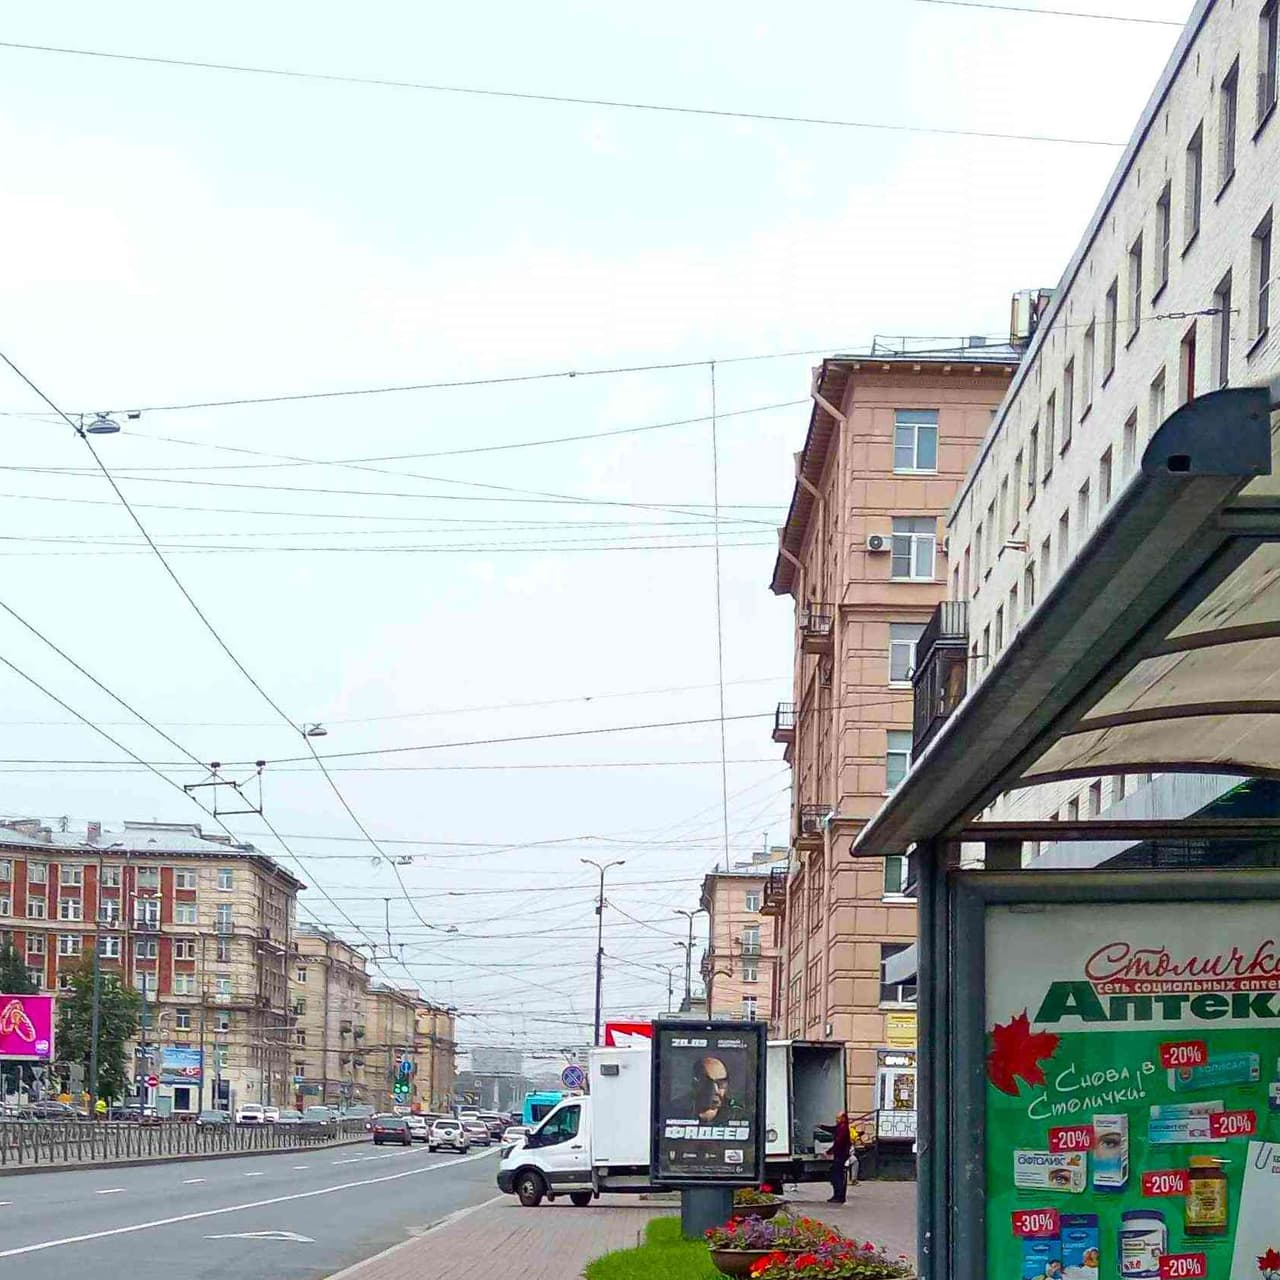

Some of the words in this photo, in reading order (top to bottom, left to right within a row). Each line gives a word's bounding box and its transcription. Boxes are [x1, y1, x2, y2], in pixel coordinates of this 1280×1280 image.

[1097, 982, 1130, 994] сеть
[1135, 979, 1235, 993] социальных
[1164, 1046, 1202, 1064] -20%
[1213, 1115, 1252, 1133] -20%
[1052, 1130, 1090, 1149] -20%
[1146, 1175, 1184, 1193] -20%
[1016, 1214, 1054, 1232] -30%
[1163, 1258, 1201, 1276] -20%
